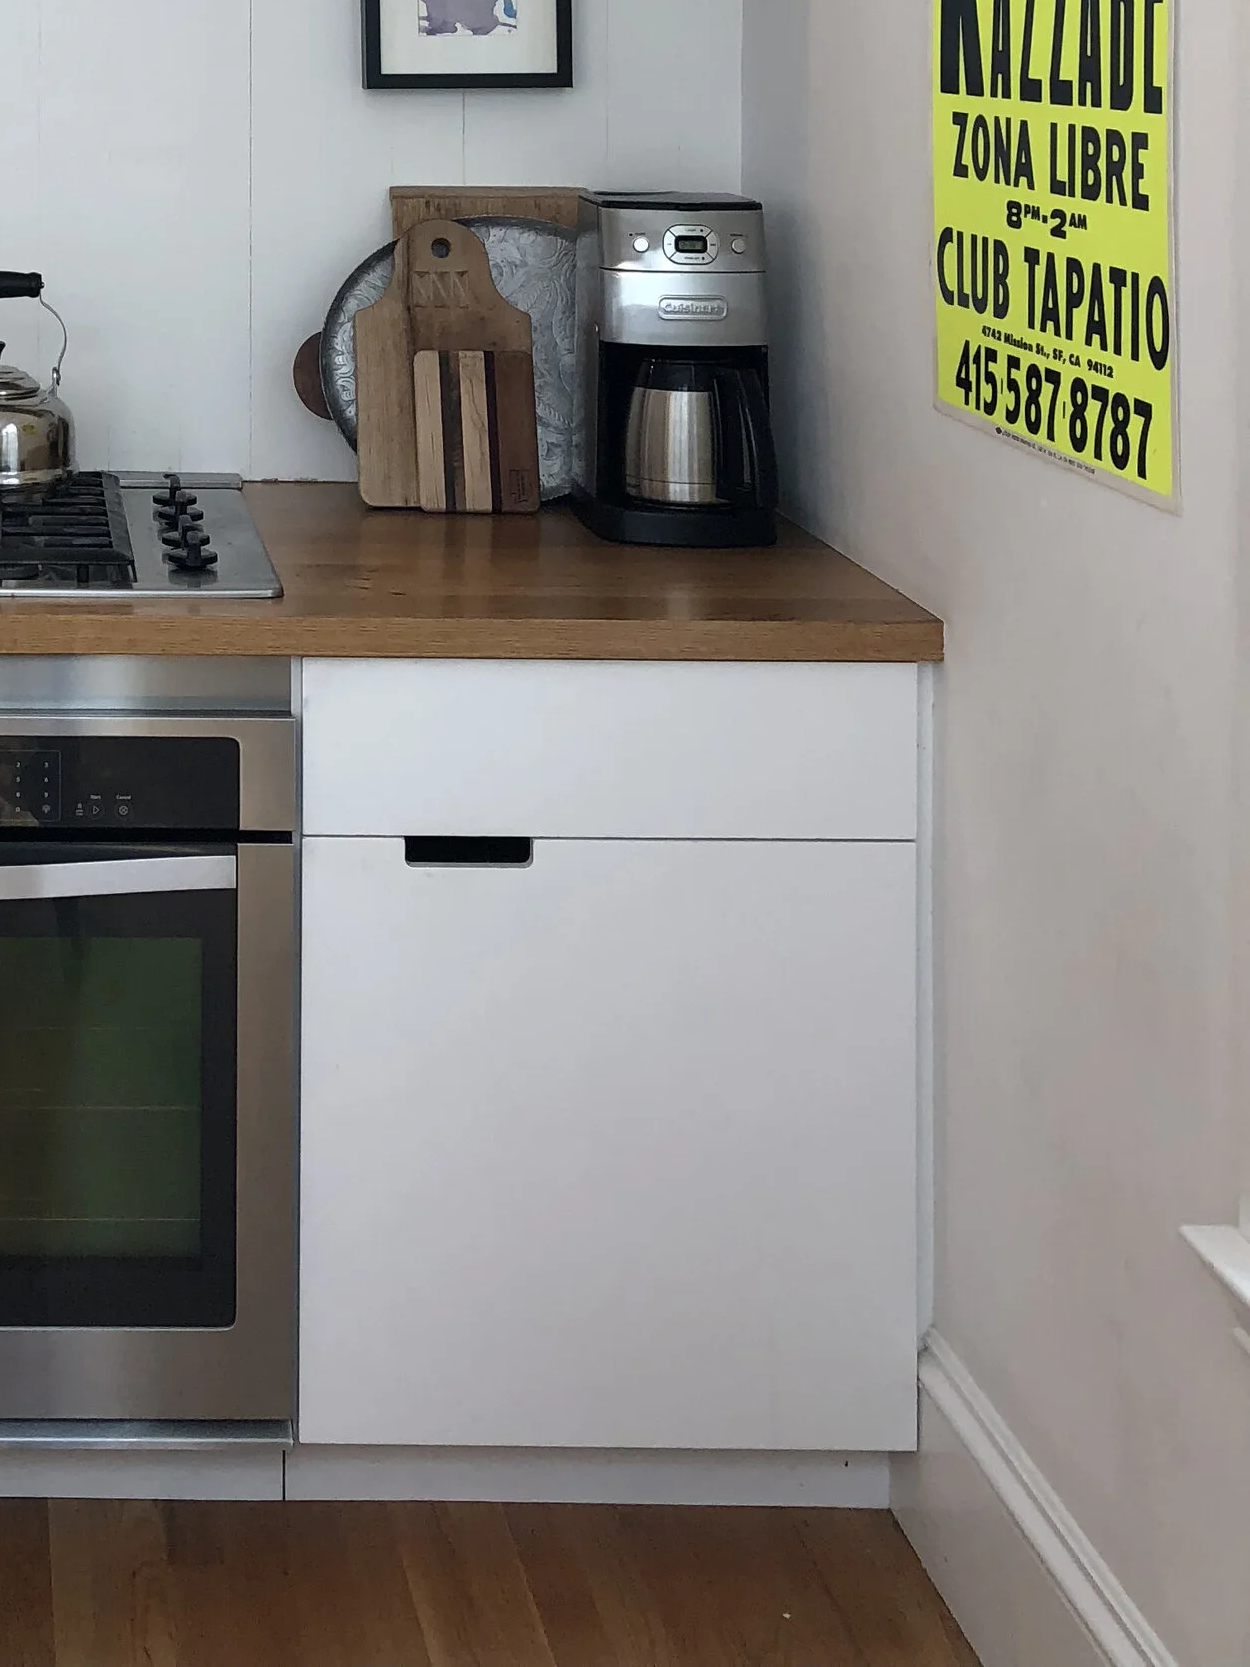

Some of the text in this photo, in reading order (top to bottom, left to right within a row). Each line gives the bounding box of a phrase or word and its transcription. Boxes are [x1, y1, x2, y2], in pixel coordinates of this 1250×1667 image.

[952, 111, 1150, 212] ZONA LIBRE
[937, 226, 1170, 371] CLUB TAPATIO
[981, 325, 1002, 341] 4742
[1004, 332, 1033, 353] Mission
[1053, 348, 1066, 365] SF,
[1069, 353, 1081, 368] CA
[1087, 358, 1114, 378] 94112
